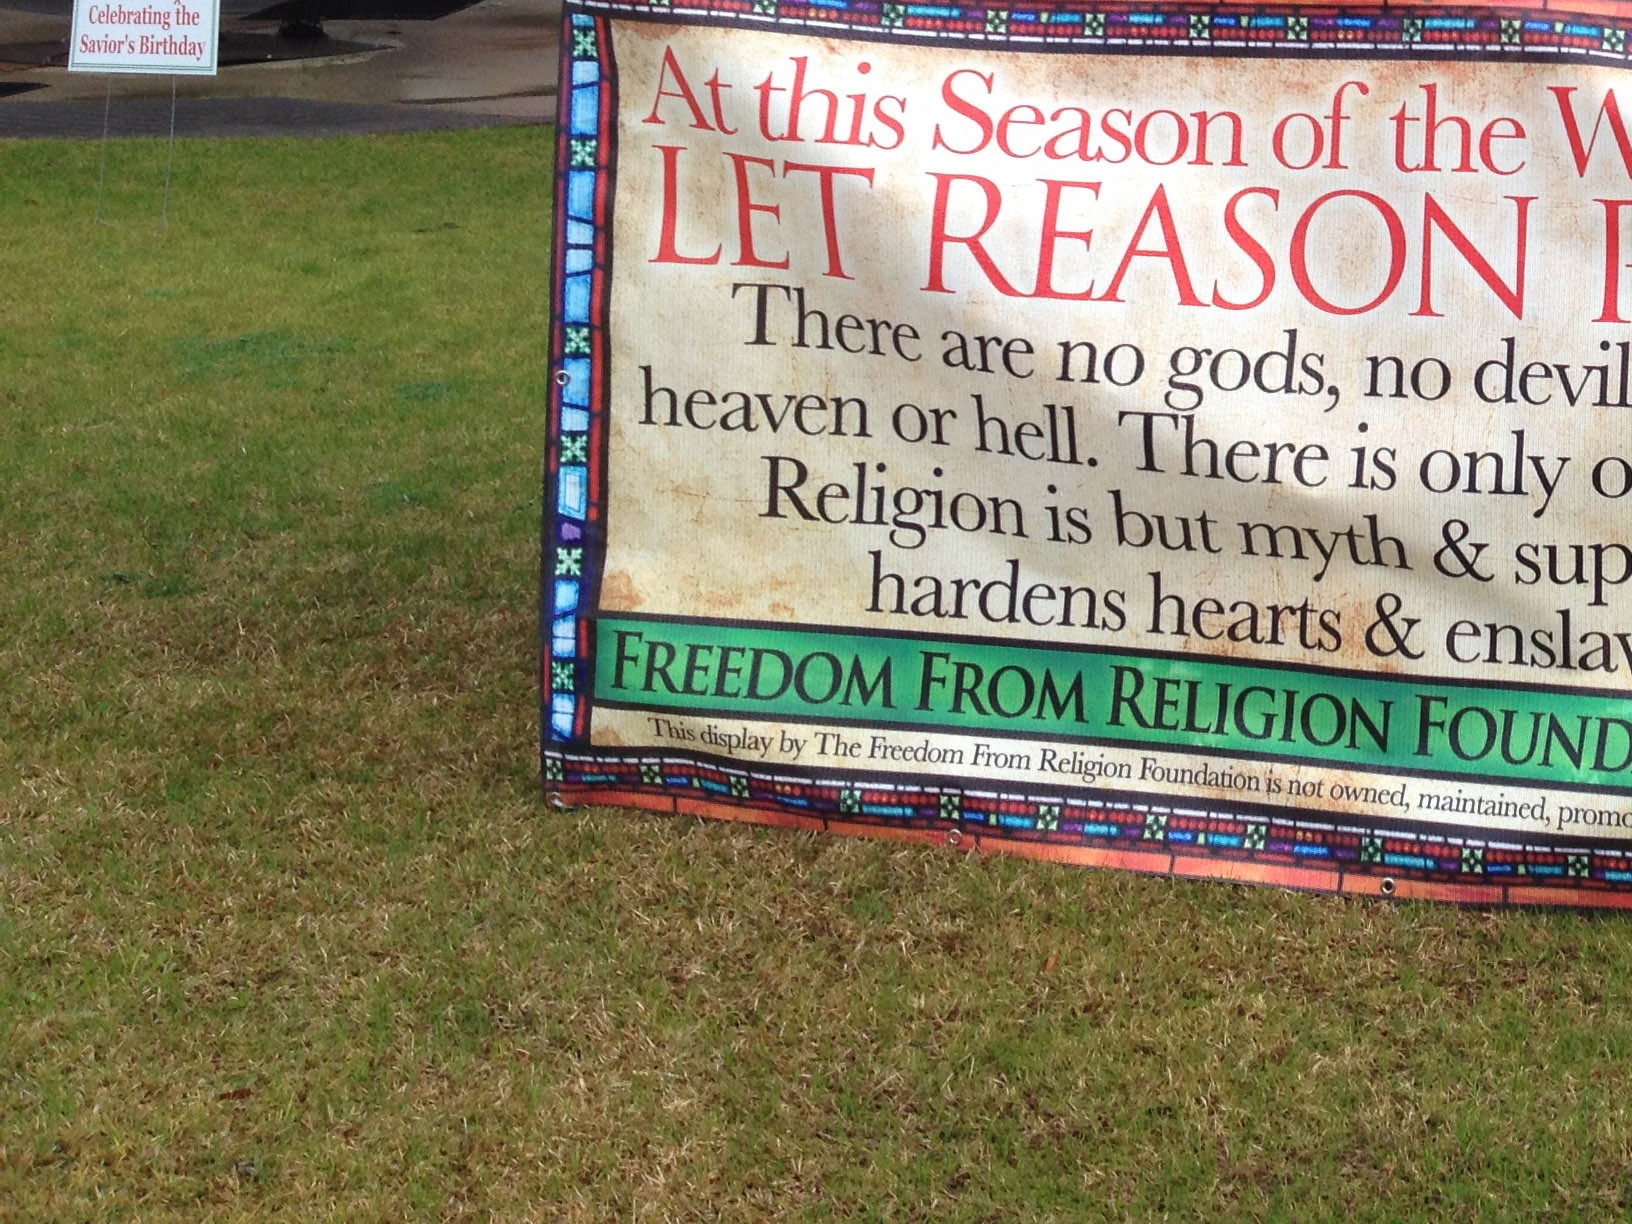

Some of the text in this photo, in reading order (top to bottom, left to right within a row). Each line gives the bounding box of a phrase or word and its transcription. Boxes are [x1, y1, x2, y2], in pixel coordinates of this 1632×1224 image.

[80, 34, 206, 60] Savior's Birthday
[89, 5, 200, 30] Celebrating the
[642, 45, 737, 136] At
[754, 56, 905, 150] this
[932, 69, 1248, 166] Season
[1272, 81, 1369, 170] of
[1390, 83, 1526, 175] the
[648, 145, 875, 280] LET
[920, 171, 1539, 321] REASON
[732, 282, 921, 361] There
[942, 331, 1035, 379] are
[1057, 339, 1145, 387] no
[1164, 328, 1340, 413] gods,
[1363, 352, 1452, 401] no
[638, 365, 872, 438] heaven
[892, 400, 957, 446] or
[970, 394, 1098, 468] hell.
[1118, 410, 1329, 488] There
[1348, 422, 1398, 491] is
[1419, 429, 1571, 518] only
[758, 455, 1026, 549] Religion
[1046, 484, 1092, 545] is
[1109, 490, 1222, 554] but
[1238, 514, 1414, 583] myth
[1433, 518, 1495, 584] &
[865, 550, 1127, 633] hardens
[1146, 571, 1342, 653] hearts
[1364, 592, 1425, 660] &
[611, 630, 896, 710] FREEDOM
[915, 650, 1089, 724] FROM
[1105, 664, 1395, 754] RELIGION
[647, 716, 699, 743] This
[700, 723, 775, 758] display
[779, 733, 808, 760] by
[814, 731, 863, 757] The
[868, 736, 965, 766] Freedom
[970, 743, 1031, 771] From
[1038, 748, 1132, 784] Religion
[1138, 756, 1261, 793] Foundation
[1265, 768, 1282, 795] is
[1288, 776, 1325, 799] not
[1330, 782, 1410, 813] owned,
[1417, 789, 1550, 826] maintained,
